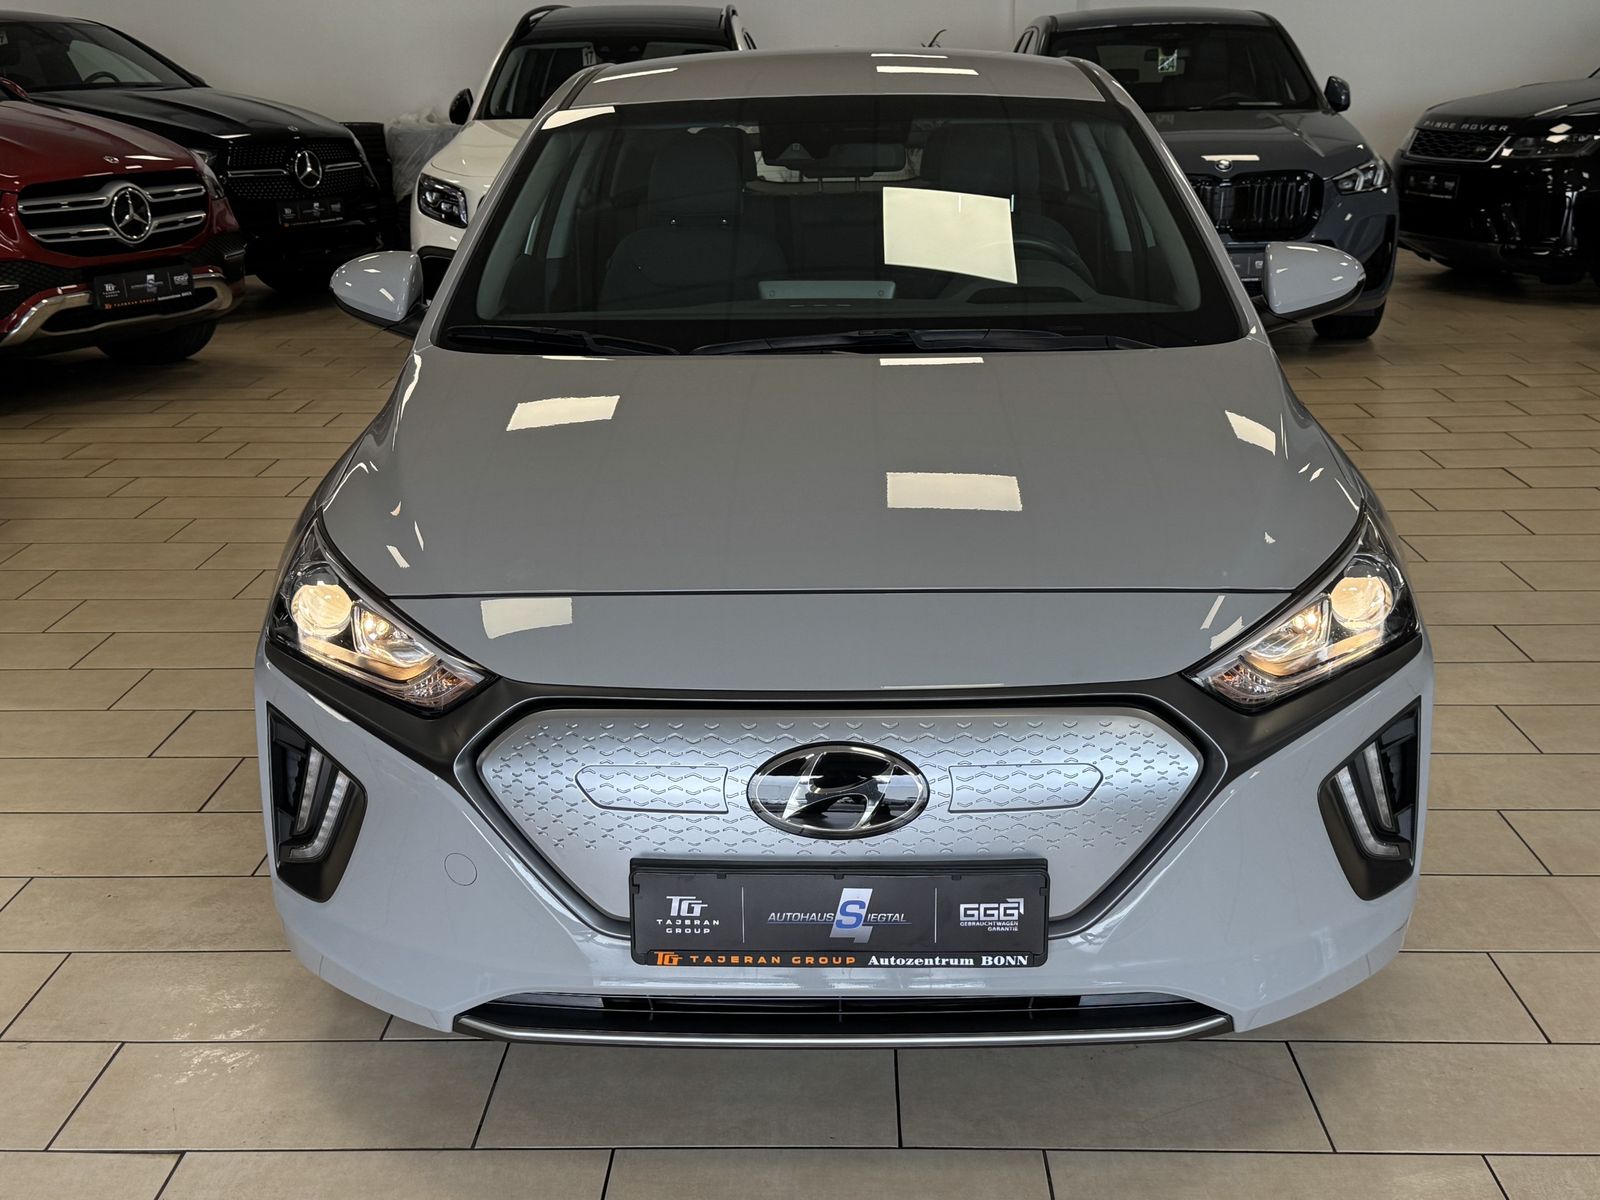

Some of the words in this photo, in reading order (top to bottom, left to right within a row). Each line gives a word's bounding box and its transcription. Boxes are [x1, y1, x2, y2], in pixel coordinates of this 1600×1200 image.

[1461, 123, 1509, 131] ROVER
[666, 895, 708, 917] TG
[959, 903, 1019, 921] GGG
[767, 912, 835, 922] AUTOHAUS
[654, 951, 683, 966] TG
[689, 955, 782, 965] TAJERAN
[791, 956, 856, 965] GROUP
[867, 955, 974, 966] Autozentrum
[980, 955, 1029, 966] BONN
